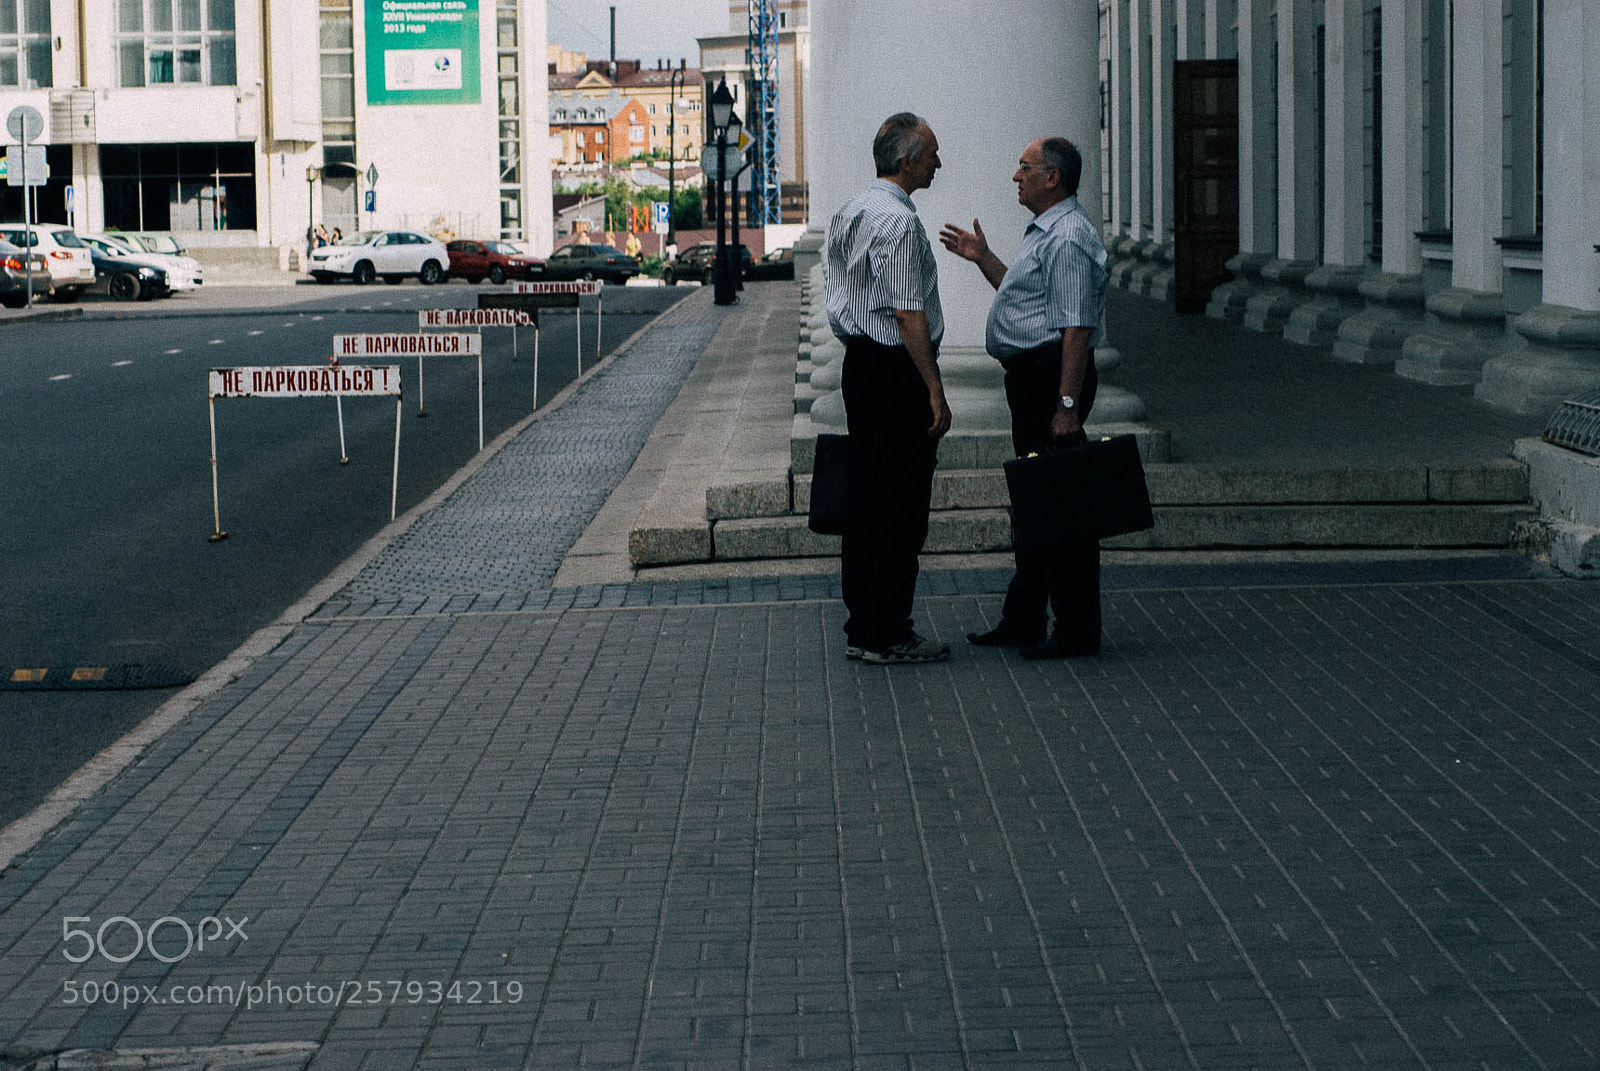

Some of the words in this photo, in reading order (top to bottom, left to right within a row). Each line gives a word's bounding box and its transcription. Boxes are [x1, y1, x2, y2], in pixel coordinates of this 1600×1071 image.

[384, 23, 405, 33] 2013
[406, 24, 426, 34] года
[659, 204, 669, 222] P
[518, 283, 528, 293] НЕ
[427, 309, 440, 325] НЕ
[343, 336, 359, 354] НЕ
[365, 335, 459, 353] ПАРКОВАТЬСЯ
[222, 371, 244, 393] НЕ
[252, 370, 374, 393] ПАРКОВАТЬСЯ
